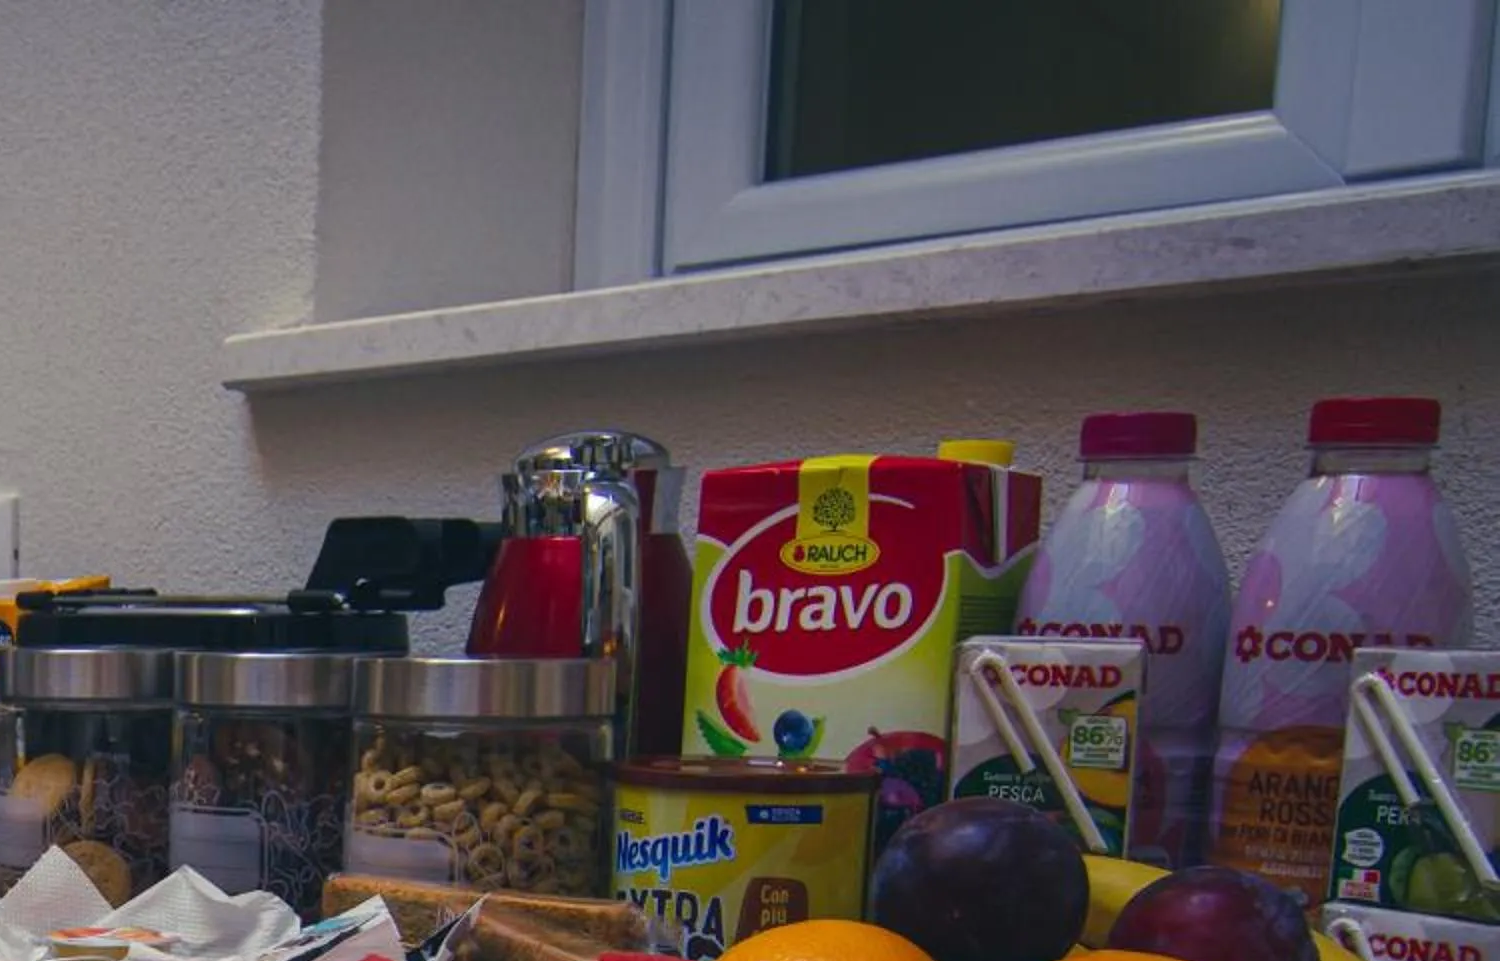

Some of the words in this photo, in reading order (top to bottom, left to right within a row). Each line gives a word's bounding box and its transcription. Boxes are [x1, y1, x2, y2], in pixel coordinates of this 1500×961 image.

[806, 543, 868, 563] RAUCH
[732, 569, 914, 634] bravo
[1009, 664, 1122, 688] CONAD
[988, 785, 1046, 803] PESCA
[615, 815, 735, 882] Nesquik
